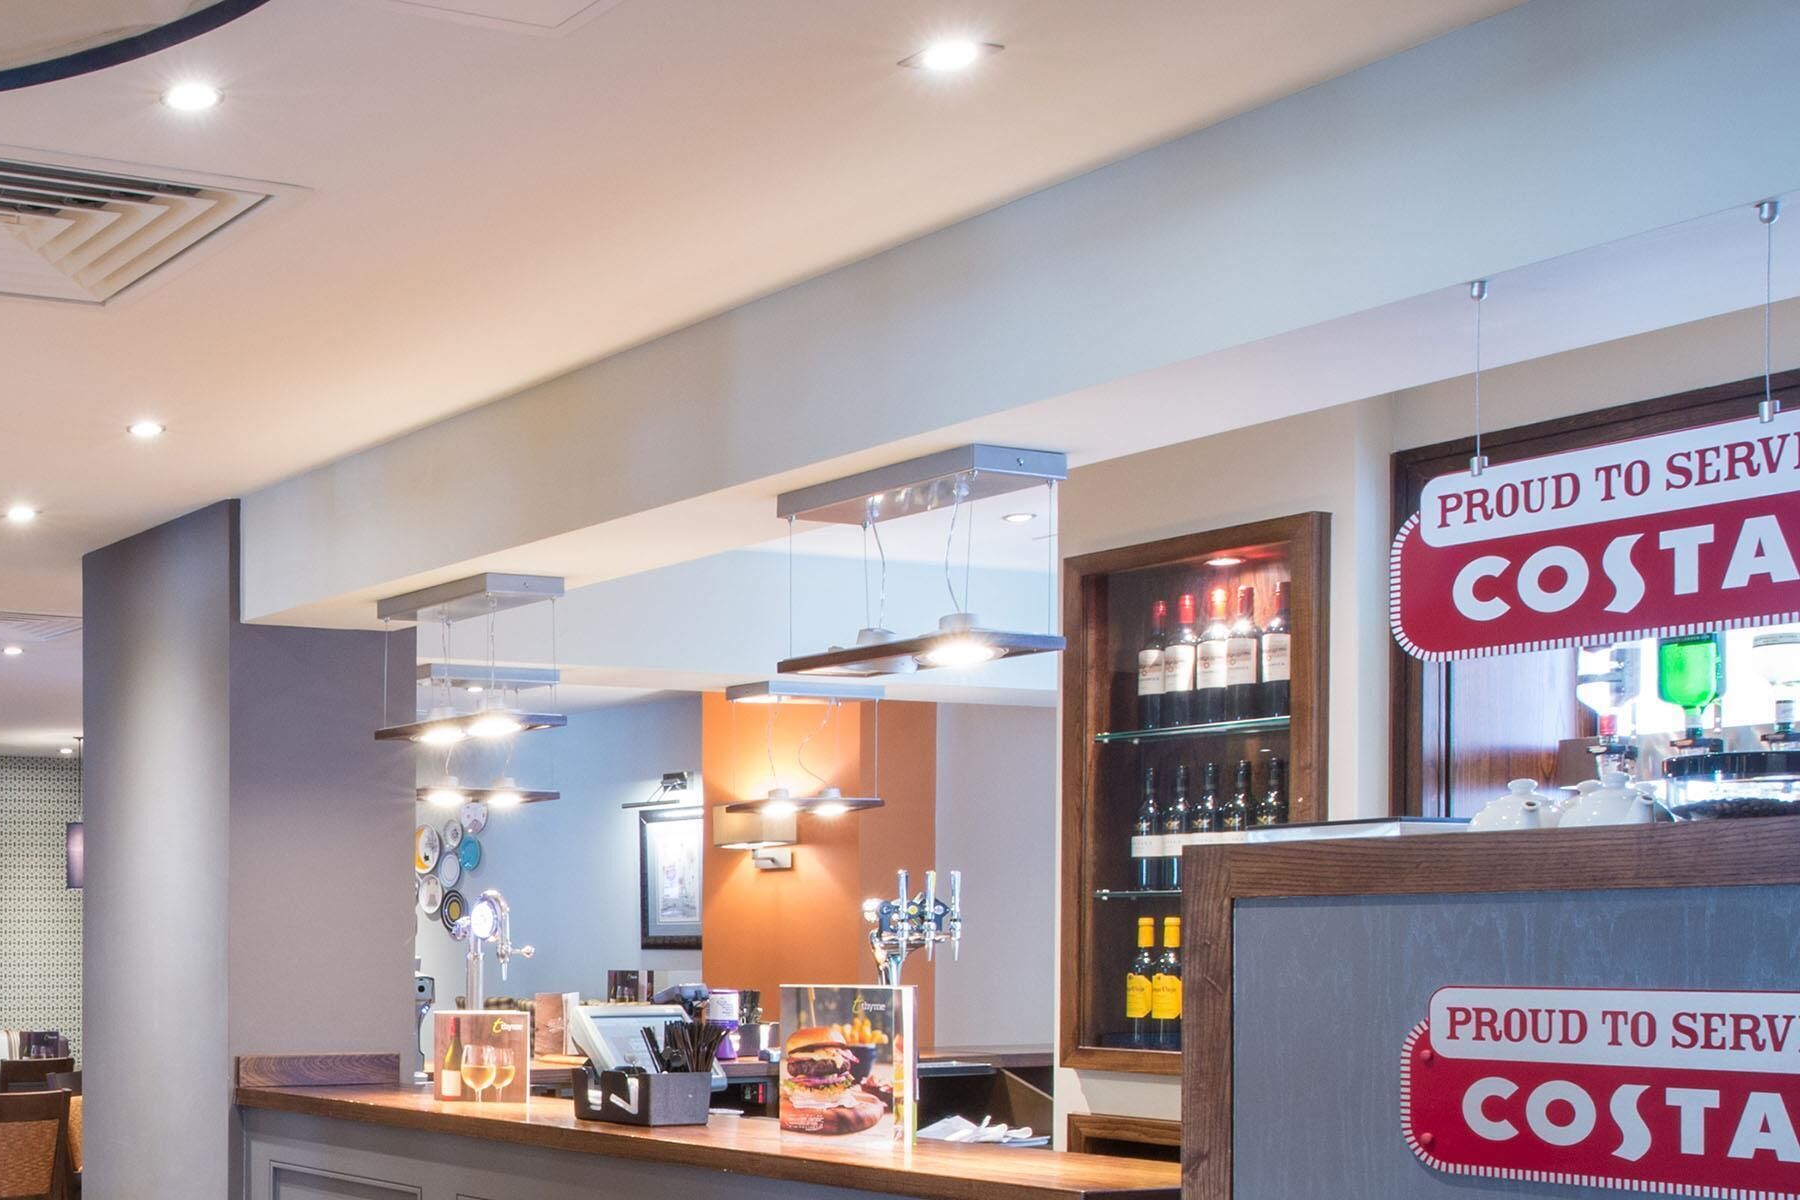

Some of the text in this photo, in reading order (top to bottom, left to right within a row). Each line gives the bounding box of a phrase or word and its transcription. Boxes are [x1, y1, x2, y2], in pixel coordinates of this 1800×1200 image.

[1436, 472, 1581, 528] PROUD
[1595, 459, 1650, 502] TO
[1452, 514, 1800, 622] COSTA
[1446, 1006, 1800, 1053] PROUD TO SERV
[1462, 1076, 1800, 1163] COSTA
